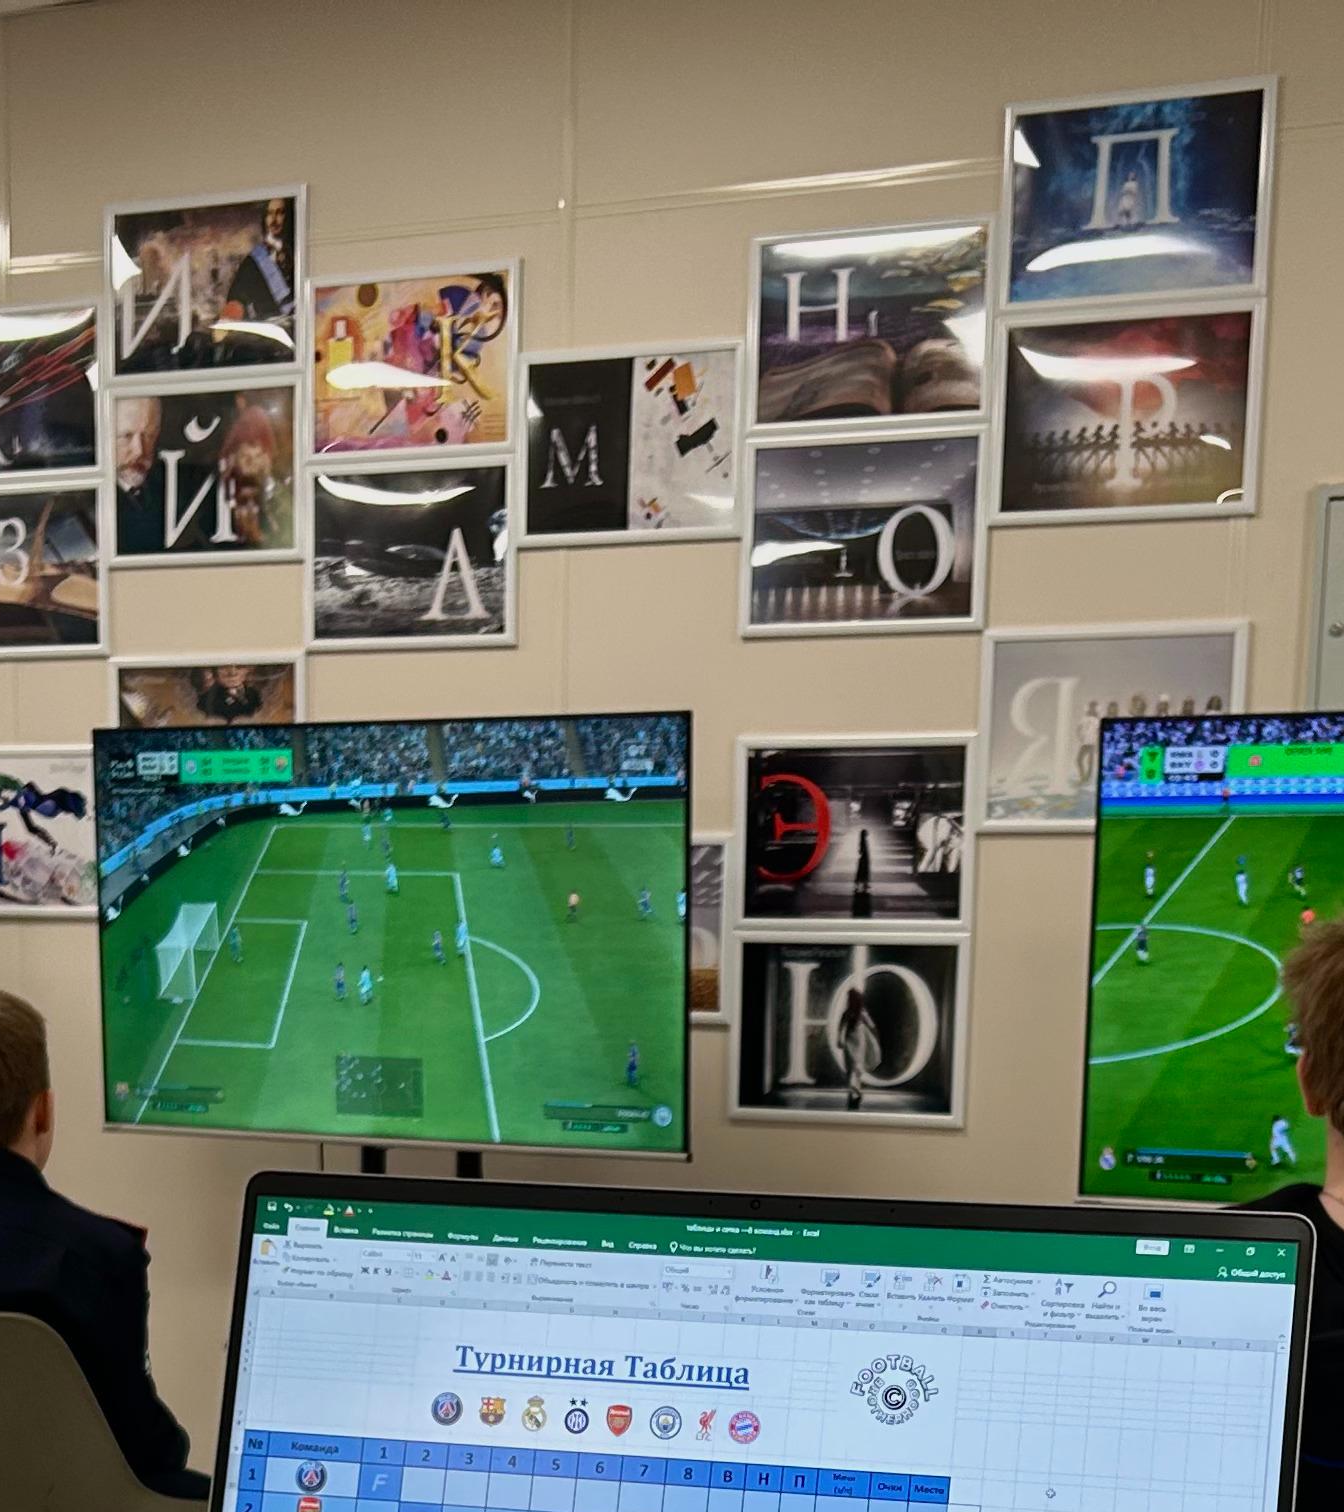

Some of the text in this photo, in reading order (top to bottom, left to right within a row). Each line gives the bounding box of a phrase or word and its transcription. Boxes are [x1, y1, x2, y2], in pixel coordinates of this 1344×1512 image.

[1083, 127, 1182, 231] П
[783, 267, 857, 342] Н
[539, 425, 604, 489] М
[1103, 372, 1179, 490] Р
[159, 414, 239, 549] Й
[877, 504, 957, 600] О
[1009, 676, 1080, 797] Я
[758, 772, 832, 882] Э
[778, 959, 941, 1088] Ю
[455, 1344, 750, 1386] Турнирная Таблица
[849, 1354, 939, 1402] FOOTBALL
[248, 1436, 263, 1451] №
[290, 1440, 340, 1456] Команда
[379, 1446, 387, 1459] 1
[421, 1448, 430, 1462] 2
[464, 1451, 474, 1465] 3
[507, 1454, 517, 1468] 4
[552, 1457, 561, 1471] 5
[595, 1460, 604, 1474] 6
[639, 1463, 649, 1477] 7
[683, 1466, 694, 1480] 8
[723, 1469, 733, 1483] В
[758, 1471, 769, 1486] Н
[794, 1473, 805, 1488] П
[877, 1481, 903, 1493] Очки
[914, 1484, 945, 1495] Место
[248, 1467, 388, 1492] 1 F
